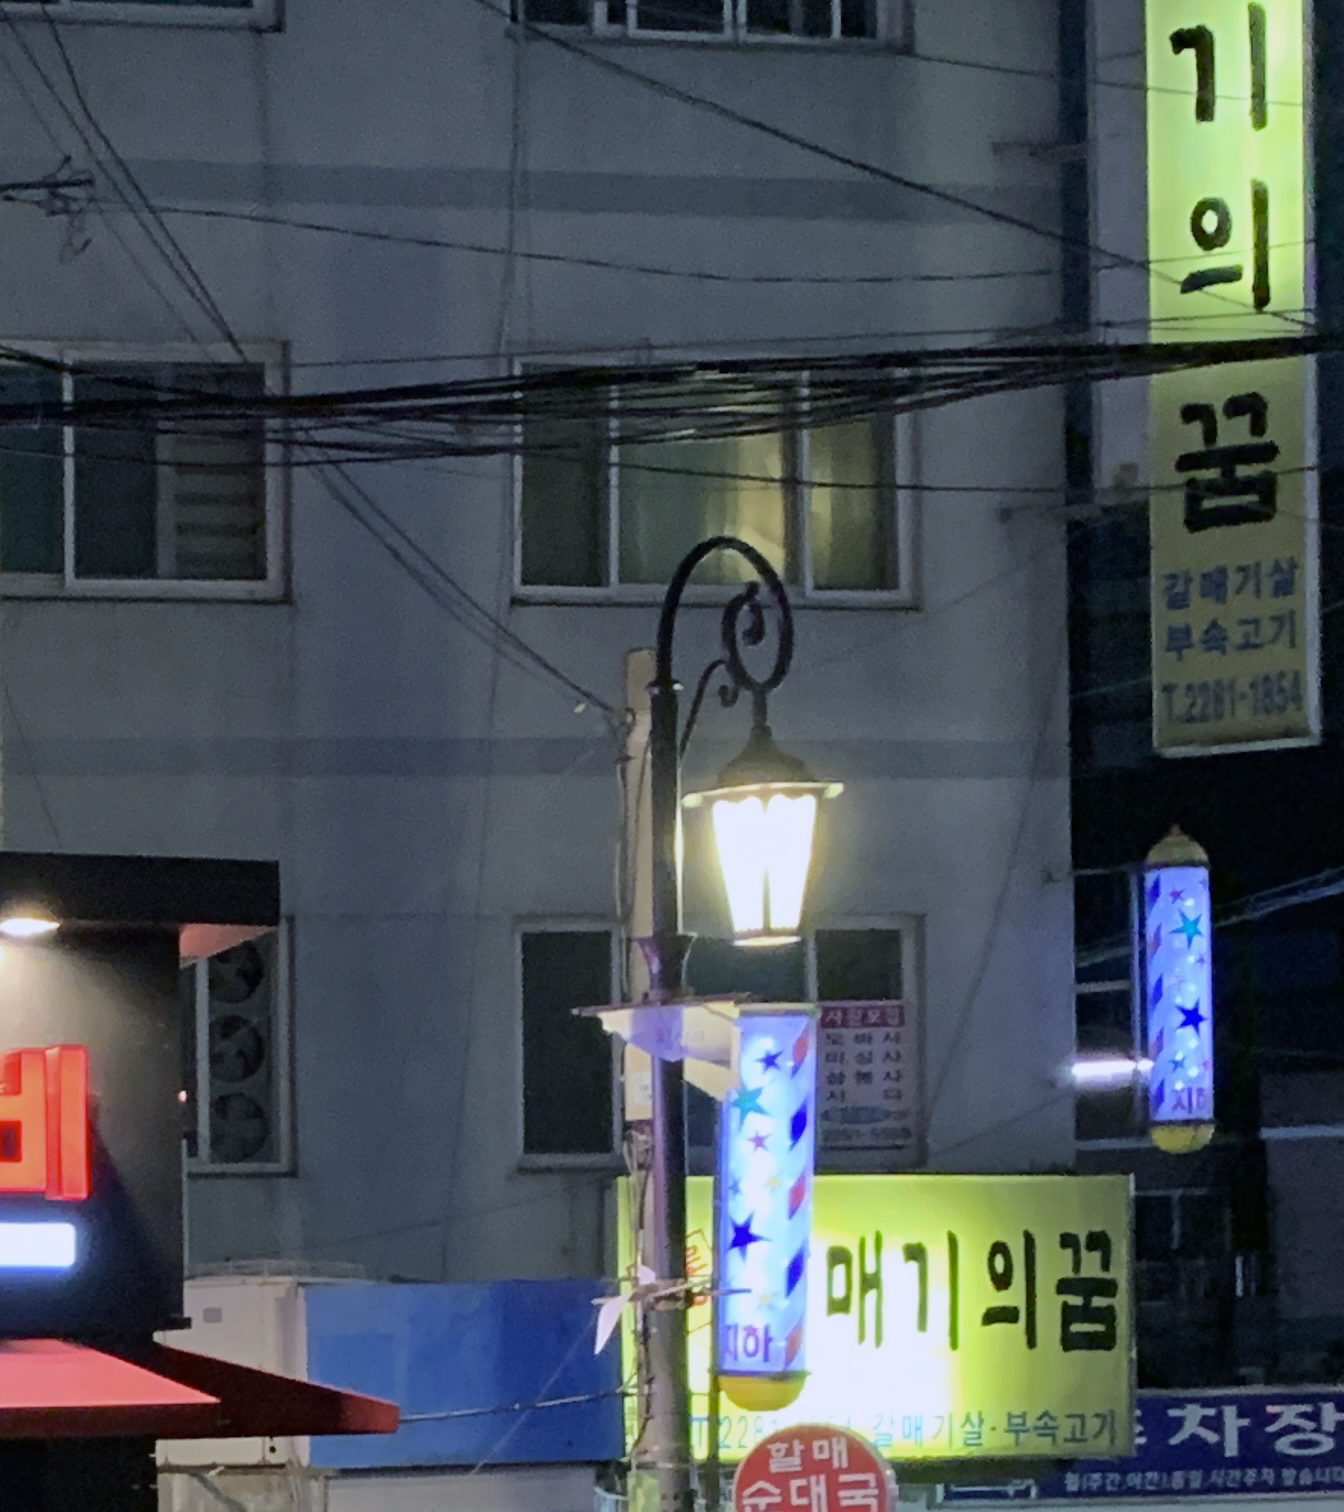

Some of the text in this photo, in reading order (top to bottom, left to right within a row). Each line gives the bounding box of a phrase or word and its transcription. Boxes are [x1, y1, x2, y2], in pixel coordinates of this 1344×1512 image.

[1162, 556, 1298, 609] 갈매기살
[1164, 609, 1296, 662] 부속고기
[767, 1436, 849, 1473] 할매
[1134, 1403, 1344, 1458] 차장
